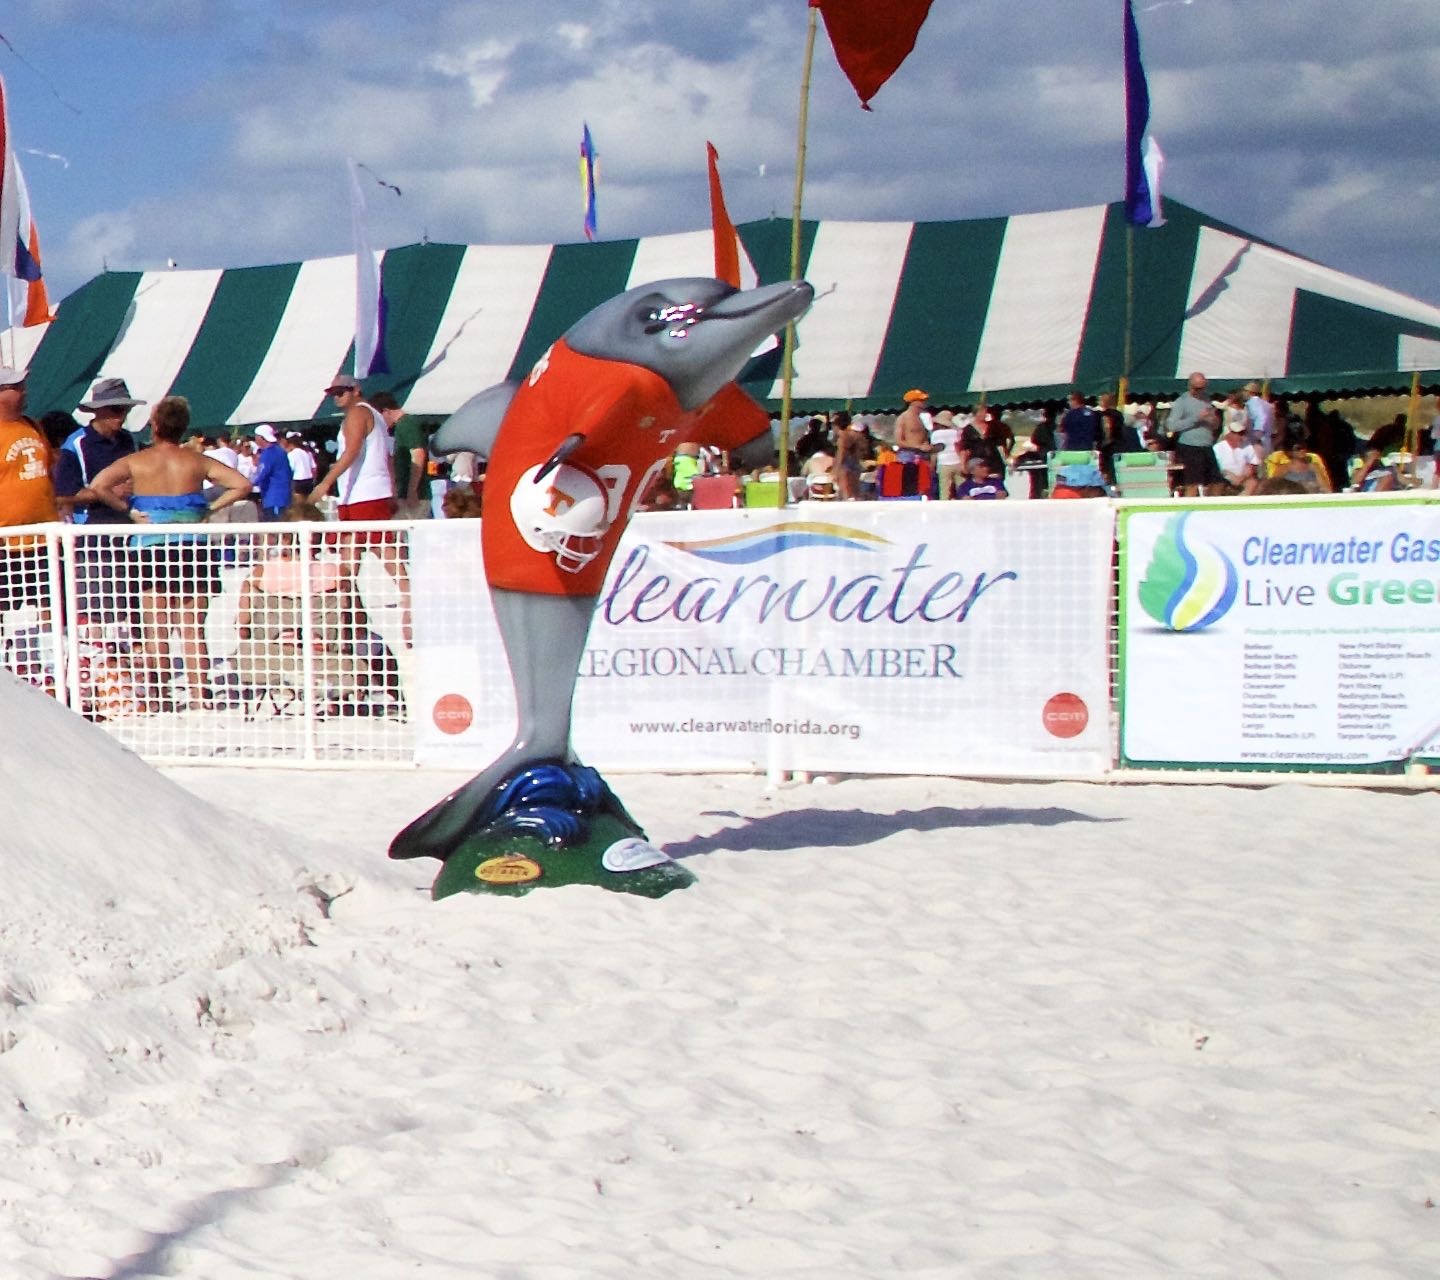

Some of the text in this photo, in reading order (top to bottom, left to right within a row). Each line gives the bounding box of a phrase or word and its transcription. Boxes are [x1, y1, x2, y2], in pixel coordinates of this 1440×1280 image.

[543, 486, 575, 518] T
[1242, 532, 1440, 566] Clearwater Gas
[594, 543, 1018, 625] learwater
[1245, 571, 1440, 606] Live Gree
[750, 643, 964, 679] CHAMBER
[629, 718, 862, 739] www.clearwaterflorida.org
